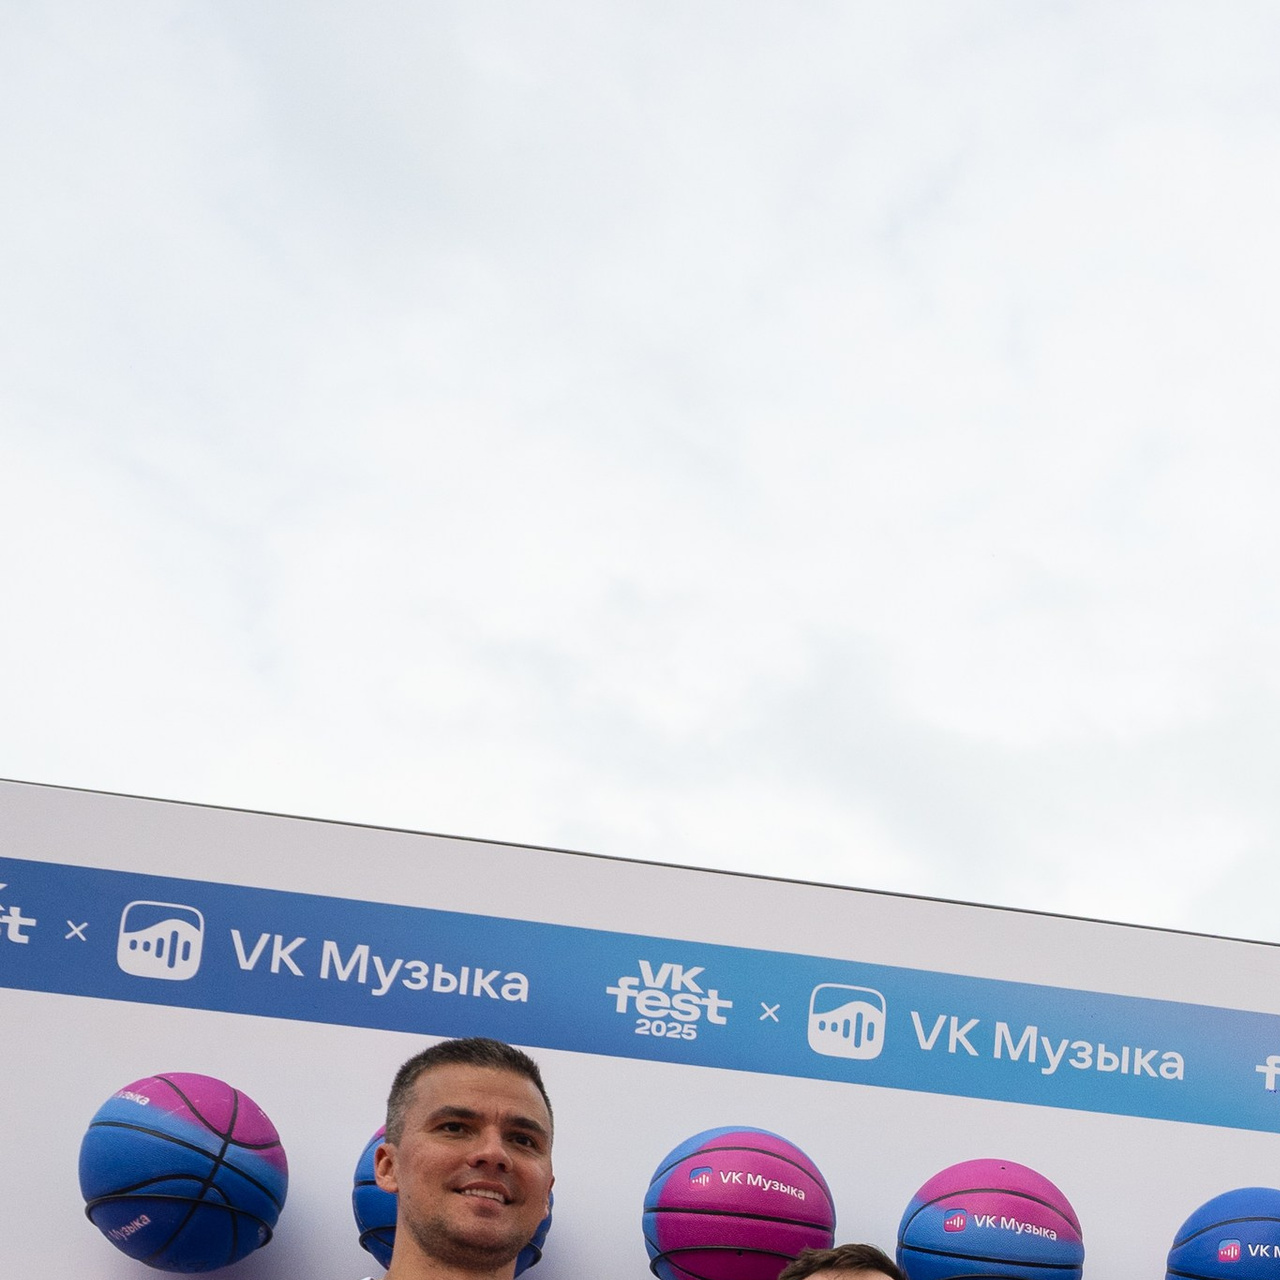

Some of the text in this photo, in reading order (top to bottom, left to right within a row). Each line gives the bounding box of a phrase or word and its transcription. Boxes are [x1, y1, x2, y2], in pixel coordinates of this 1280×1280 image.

[230, 928, 531, 1003] VK Музыка
[638, 960, 706, 993] VK
[606, 976, 733, 1025] fest
[634, 1019, 698, 1041] 2025
[911, 1010, 1185, 1081] VK Музыка
[719, 1171, 806, 1200] VK Музыка
[973, 1214, 1057, 1241] VK Музыка
[1248, 1244, 1270, 1258] VK
